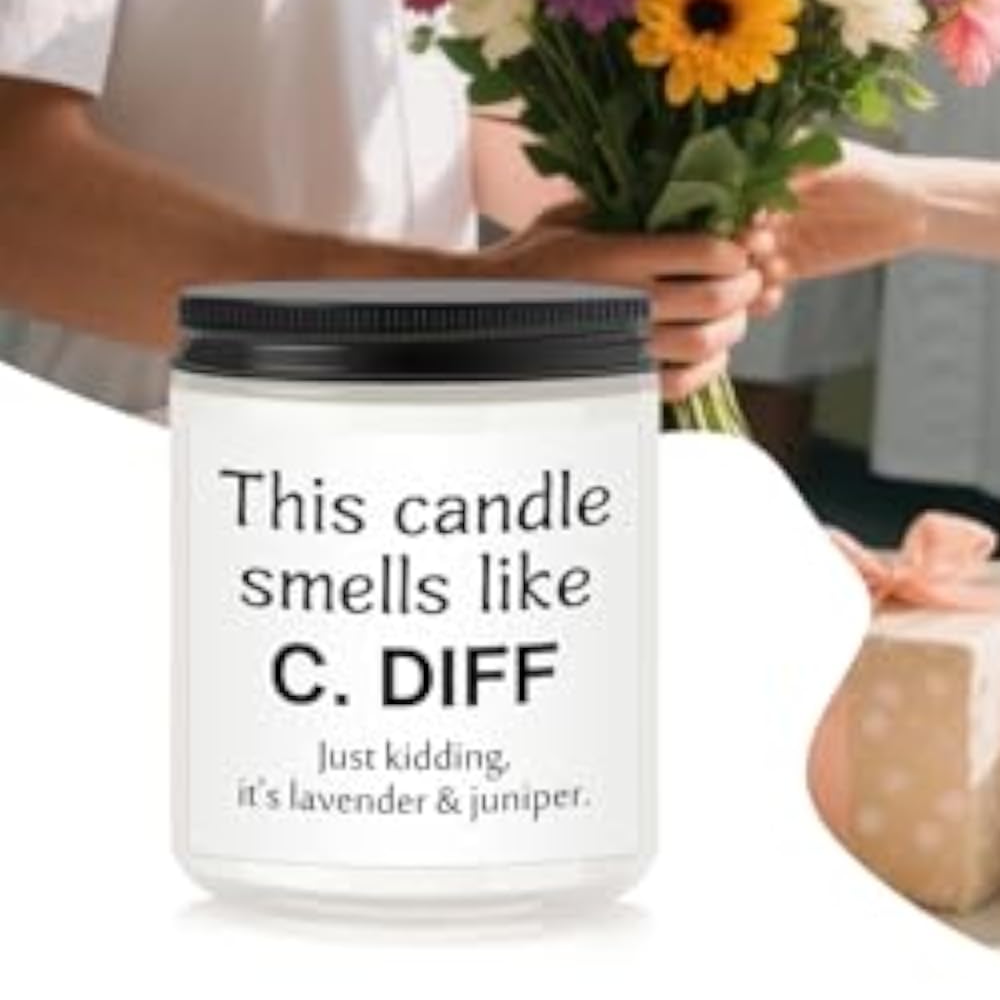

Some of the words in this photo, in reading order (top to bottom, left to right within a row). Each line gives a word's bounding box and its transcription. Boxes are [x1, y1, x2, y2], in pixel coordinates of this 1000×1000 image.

[218, 468, 366, 535] This
[394, 469, 612, 537] candle
[239, 553, 450, 615] smells
[480, 549, 591, 614] like
[270, 641, 350, 707] C.
[381, 641, 559, 708] DIFF
[317, 740, 376, 774] Just
[385, 740, 511, 781] kidding,
[237, 776, 280, 809] it's
[289, 780, 426, 815] lavender
[437, 786, 463, 815] &
[469, 783, 592, 822] juniper.
